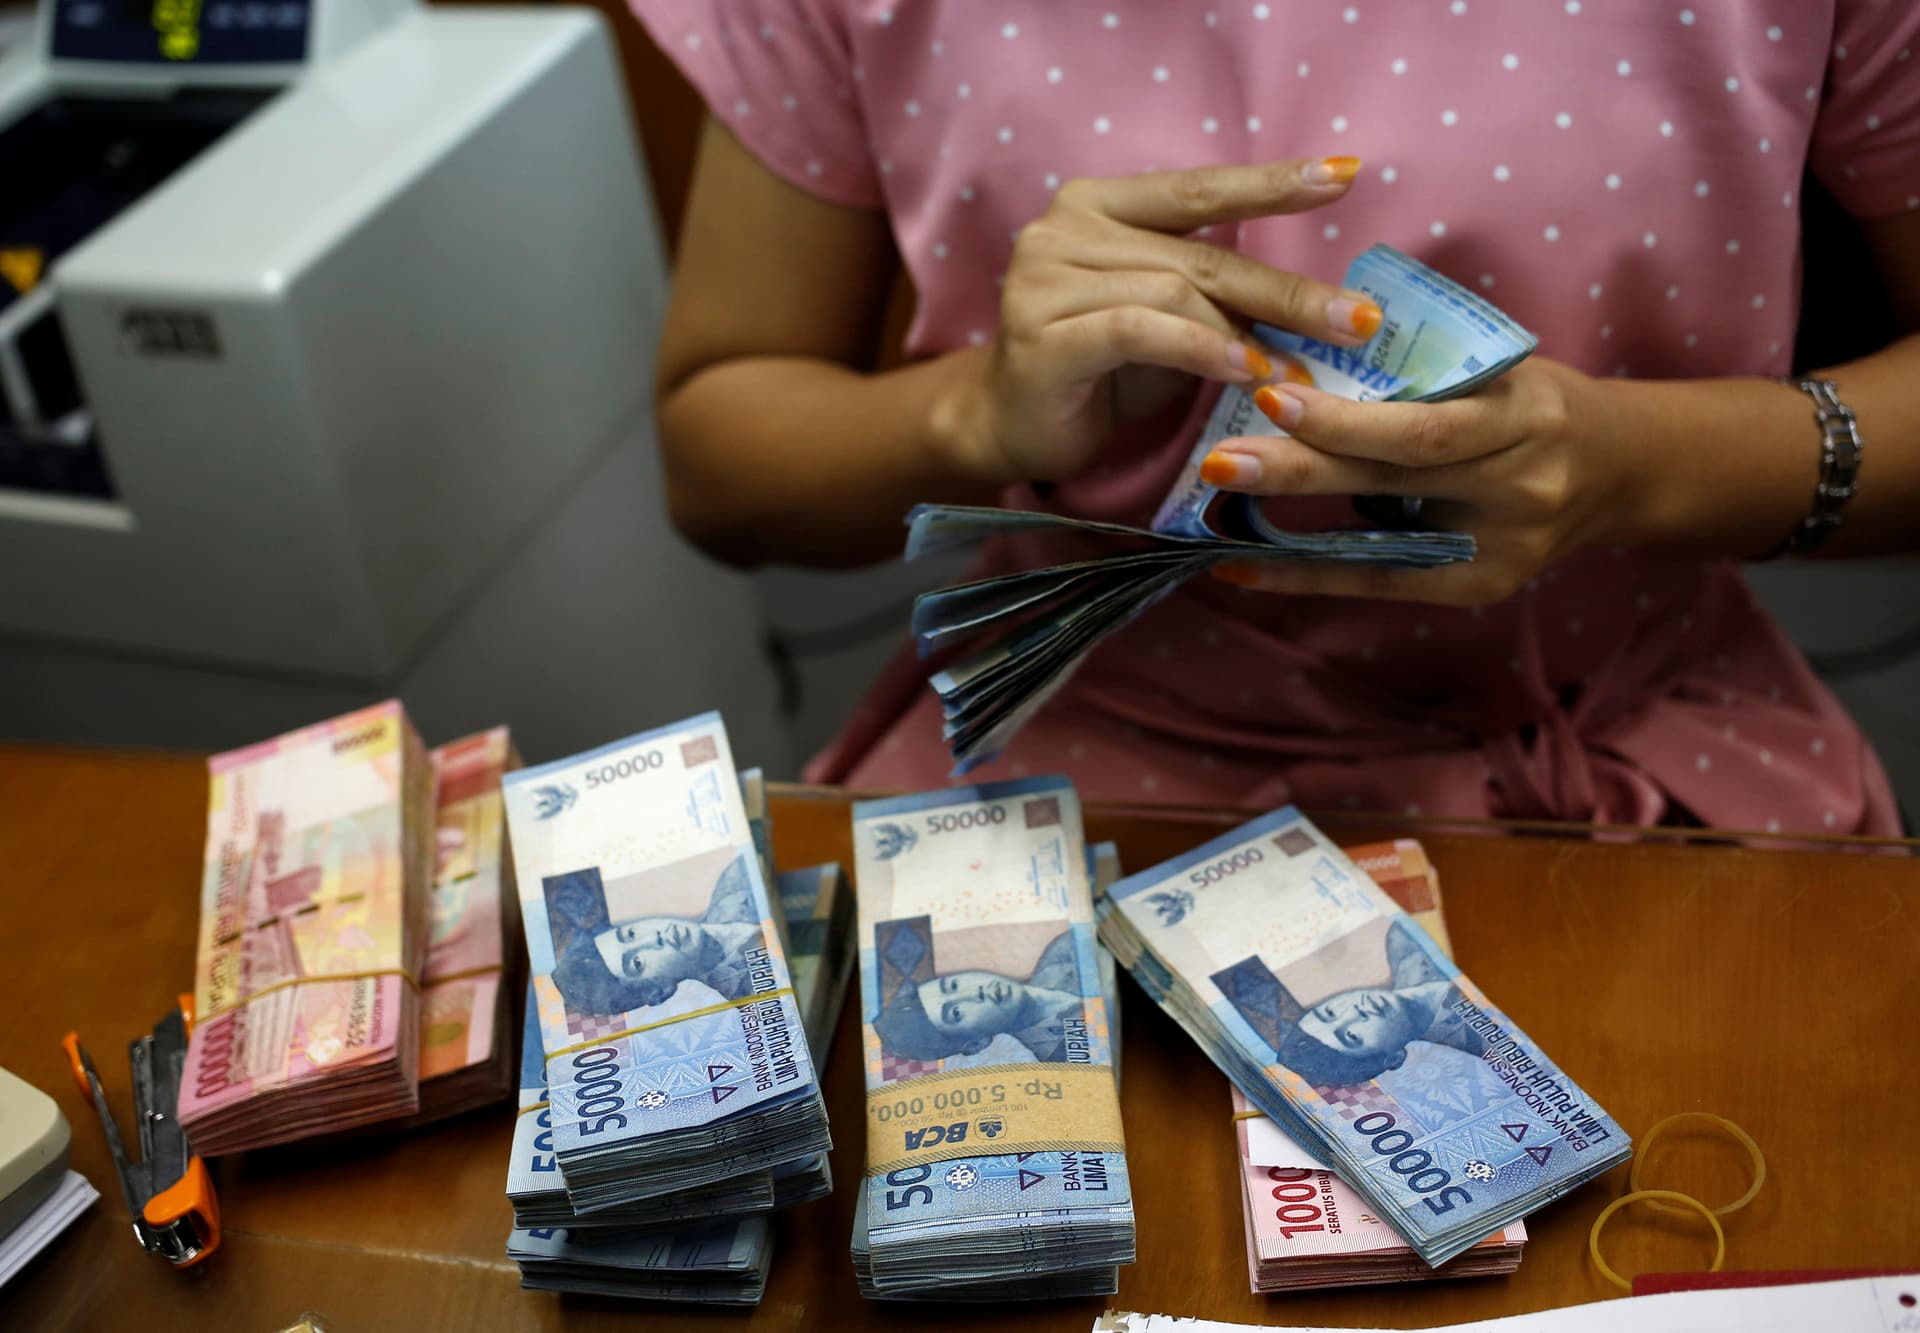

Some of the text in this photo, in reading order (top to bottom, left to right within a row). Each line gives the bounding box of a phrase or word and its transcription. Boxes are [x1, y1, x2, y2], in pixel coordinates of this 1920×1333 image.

[584, 750, 664, 790] 50000
[926, 804, 1006, 835] 50000
[1190, 847, 1264, 889] 50000
[746, 946, 800, 1086] LIMA PULUH RIBU UPIAH
[739, 1002, 773, 1092] BANK INDONESIA
[1066, 1018, 1091, 1065] UPIAH
[572, 1047, 628, 1137] 50000
[1016, 1079, 1063, 1100] Rp.
[1453, 999, 1612, 1145] LIMA PULUH RIBU RUPIAH
[1482, 1047, 1591, 1153] BANK INDONESIA
[904, 1122, 969, 1152] BCA
[1060, 1151, 1081, 1190] BANK
[1082, 1157, 1109, 1190] LIMA
[1353, 1111, 1474, 1216] 50000
[1318, 1174, 1342, 1235] SERATUS RIBU
